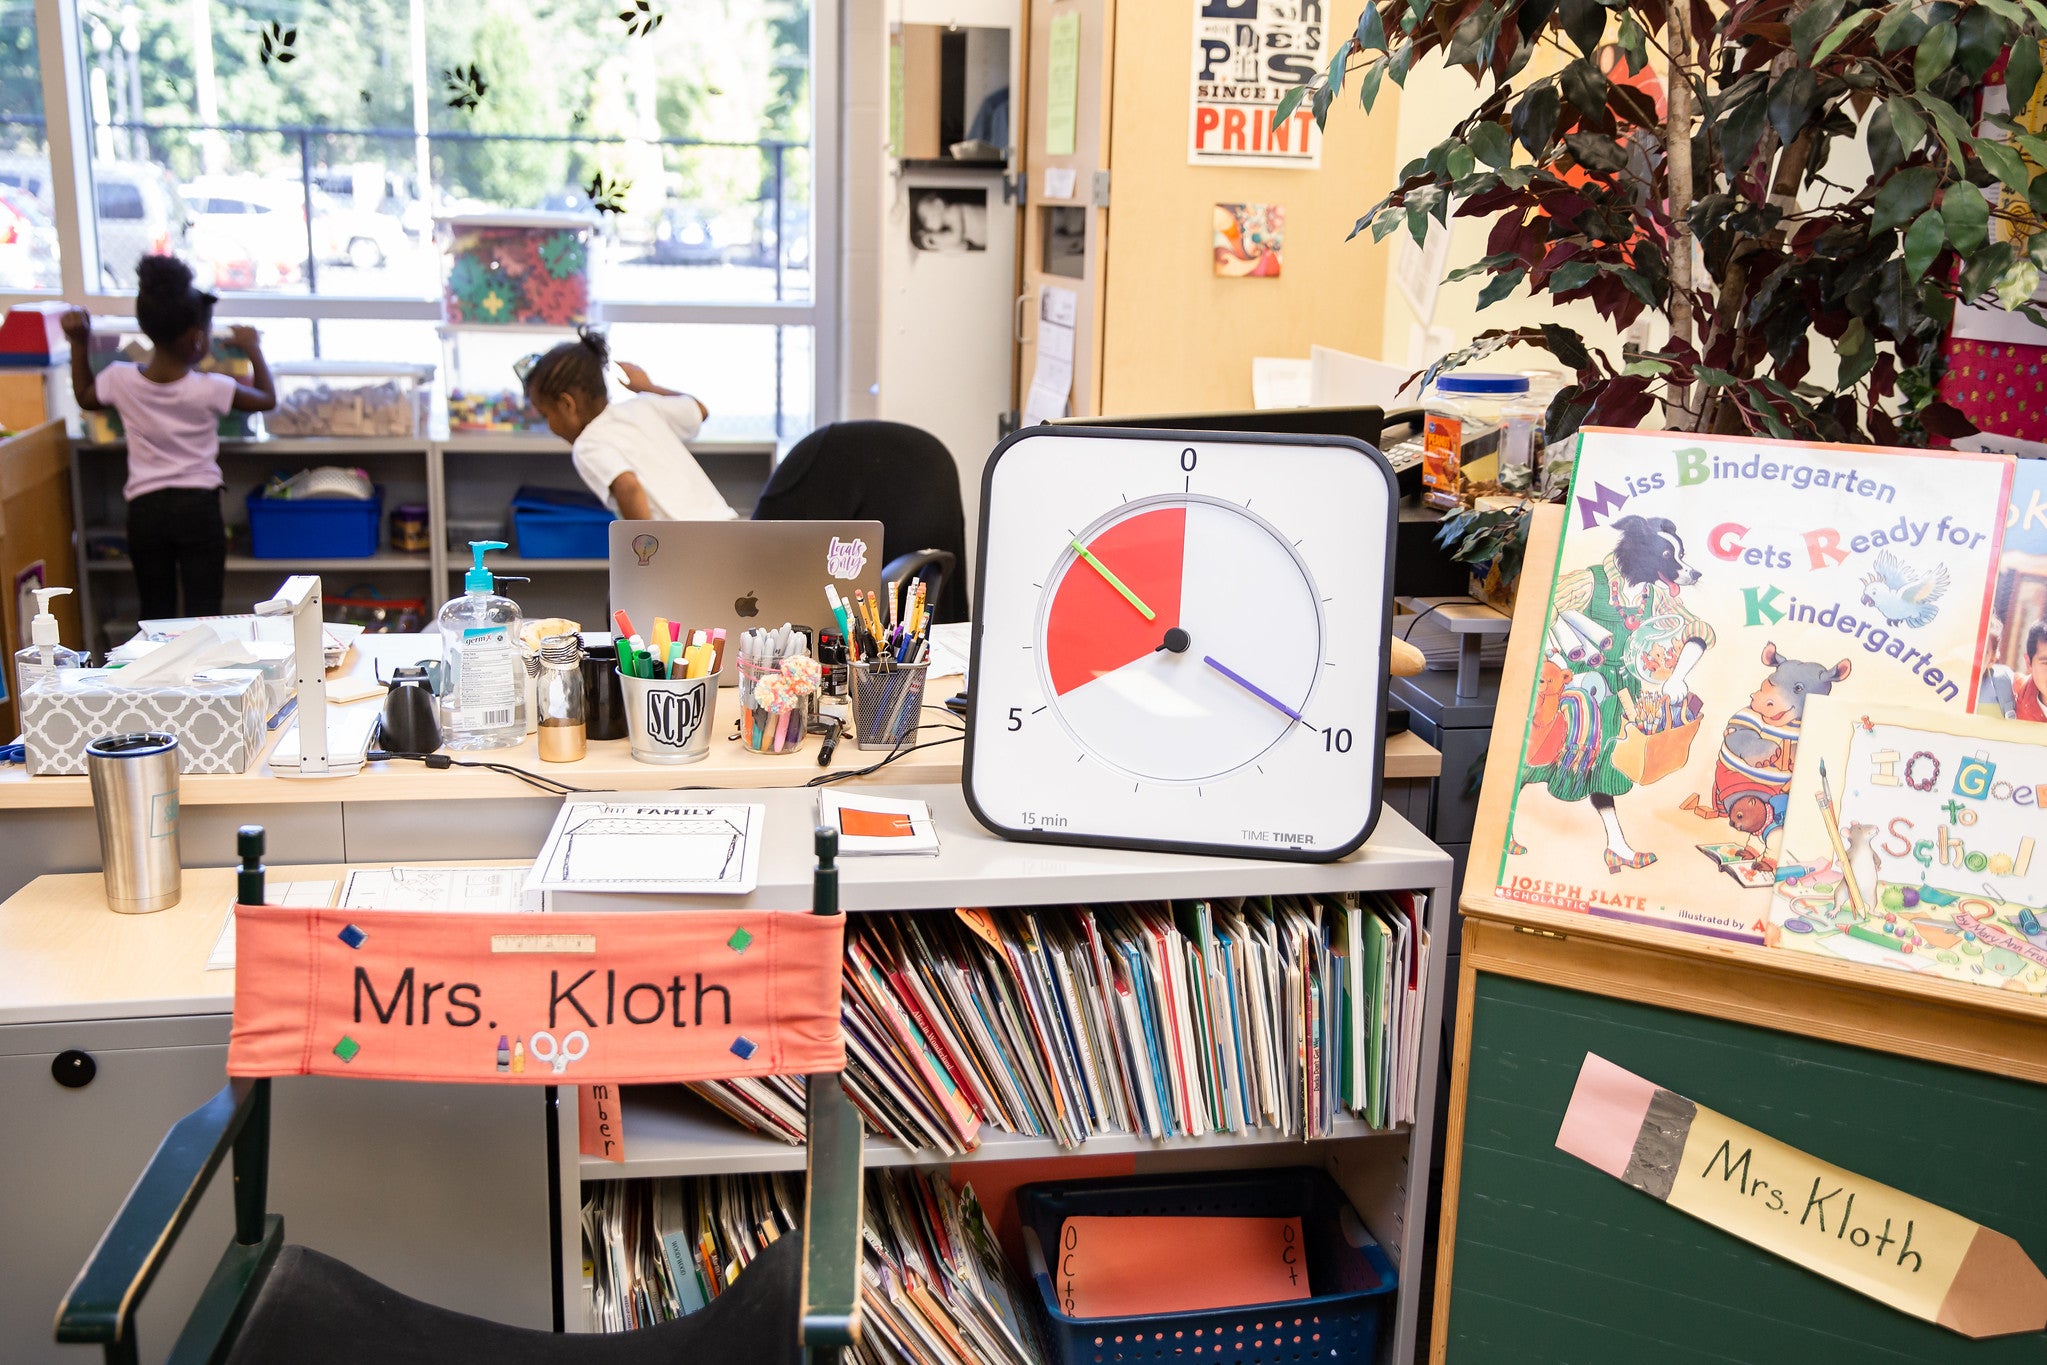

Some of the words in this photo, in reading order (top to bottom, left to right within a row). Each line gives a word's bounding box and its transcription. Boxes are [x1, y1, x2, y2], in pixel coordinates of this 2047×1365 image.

[1198, 85, 1266, 99] SINCE
[1196, 107, 1316, 153] PRINT
[1180, 447, 1197, 472] 0
[1576, 471, 1665, 530] Miss
[1673, 447, 1897, 504] Bindergarten
[830, 539, 862, 557] Locals
[1707, 522, 1792, 569] Gets
[1801, 515, 1930, 572] Ready
[1936, 515, 1986, 550] for
[829, 555, 861, 578] Only
[1740, 584, 1960, 703] Kindergarten
[650, 687, 704, 744] SCPA
[1007, 708, 1023, 732] 5
[1321, 728, 1353, 753] 10
[1953, 757, 2047, 808] Goe
[637, 808, 715, 816] FAMILY
[1021, 812, 1036, 825] 15
[1041, 813, 1068, 827] min
[1941, 799, 1978, 826] to
[1241, 830, 1269, 841] TIME
[1881, 816, 2035, 878] School
[1505, 889, 1587, 910] SCHOLASTIC
[1511, 875, 1582, 899] JOSEPH
[1589, 889, 1647, 911] SLATE
[1678, 909, 1730, 927] illustrated
[1732, 920, 1745, 931] by
[1956, 914, 1970, 926] by
[1970, 923, 2000, 943] Mary
[2000, 937, 2023, 952] Ann
[354, 966, 497, 1029] Mrs.
[549, 969, 732, 1028] Kloth
[912, 1010, 925, 1027] Alice
[922, 1025, 929, 1034] in
[928, 1032, 955, 1070] Wonderland
[1701, 1139, 1789, 1215] Mrs.
[1799, 1176, 1923, 1273] Kloth
